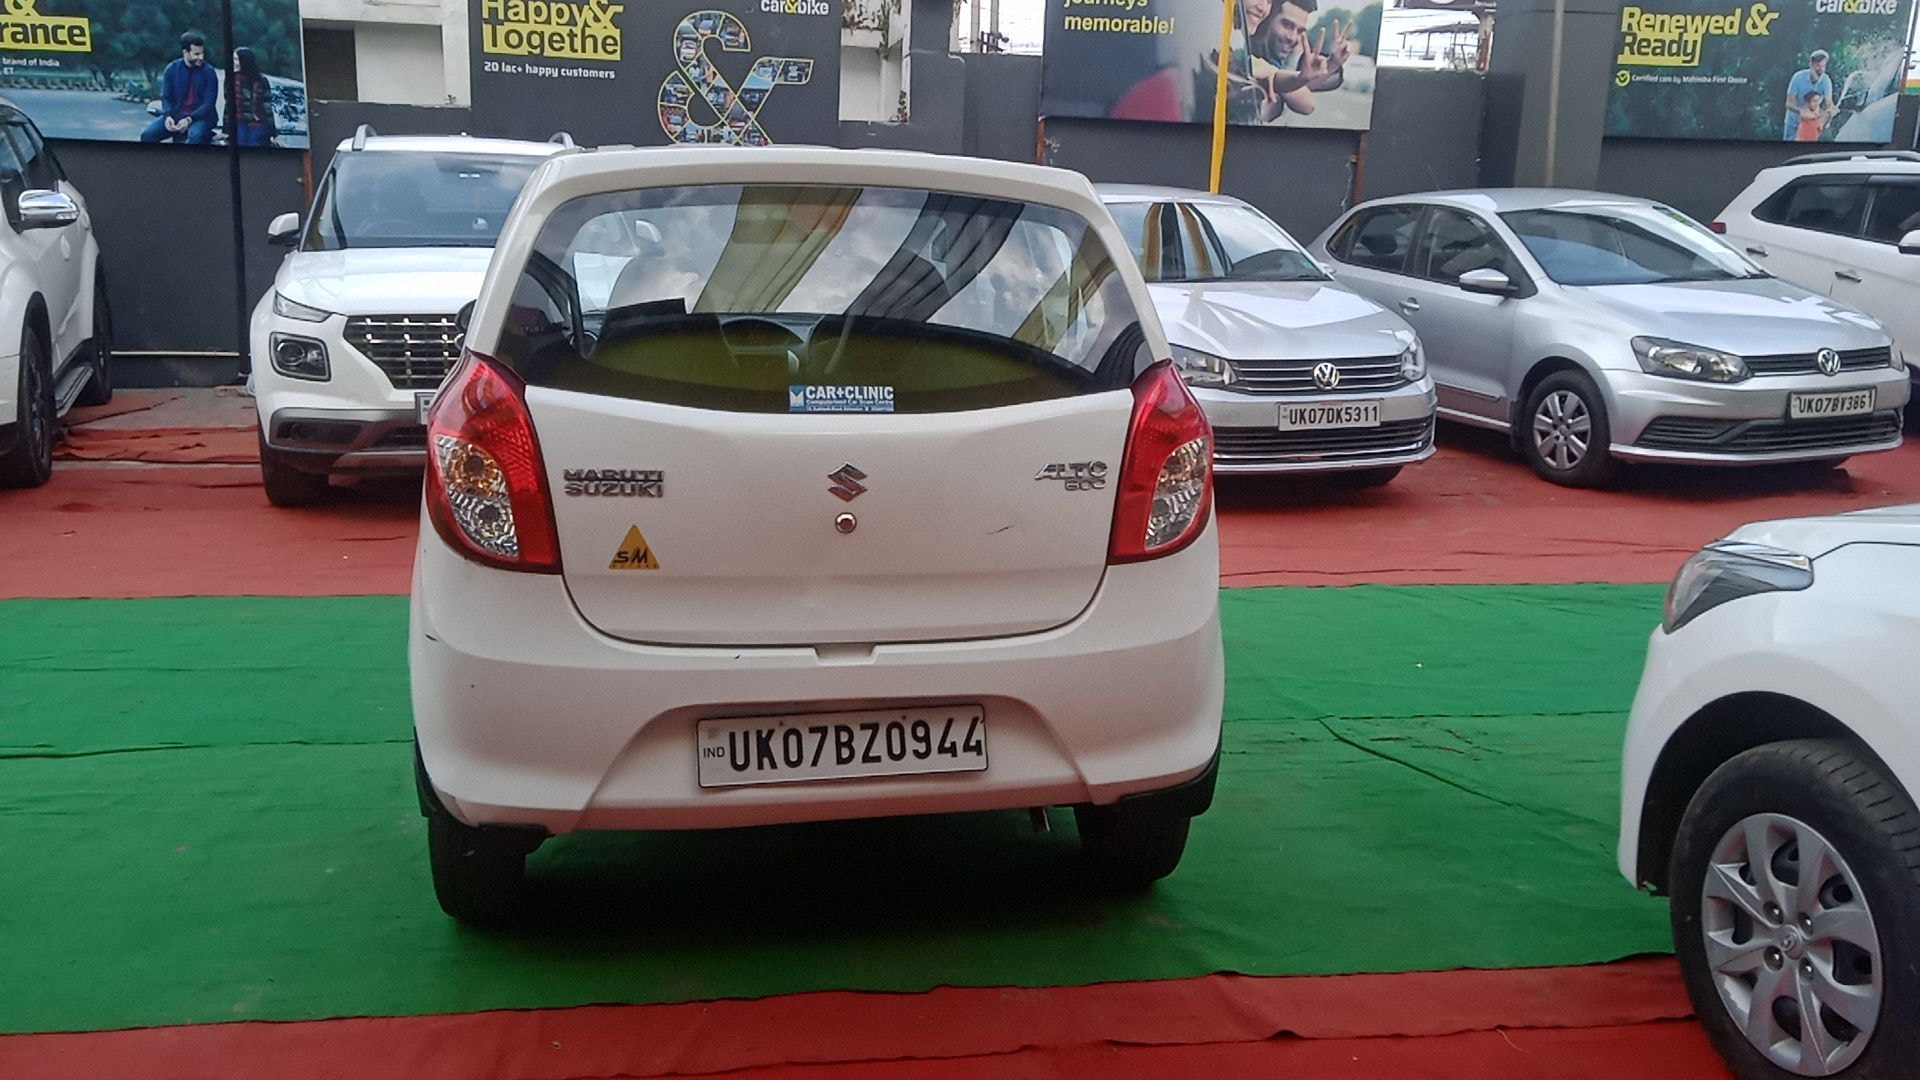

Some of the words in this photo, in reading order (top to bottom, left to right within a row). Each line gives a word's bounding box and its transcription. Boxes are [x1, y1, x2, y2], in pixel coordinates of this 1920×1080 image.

[1064, 15, 1175, 34] memorable!
[1620, 6, 1742, 35] Renewed
[1745, 3, 1780, 36] &
[1619, 31, 1698, 64] Ready
[2, 57, 26, 66] brand
[28, 57, 37, 66] of
[38, 58, 60, 67] India
[484, 61, 499, 72] 20
[502, 62, 522, 74] lac+
[525, 63, 558, 78] happy
[560, 67, 616, 79] customers
[1289, 404, 1379, 425] UK07DK5311
[563, 468, 665, 482] MARUTI
[564, 481, 665, 498] SUZUKI
[612, 546, 650, 564] SM
[703, 746, 726, 759] IND
[729, 717, 984, 772] UK07BZ0944
